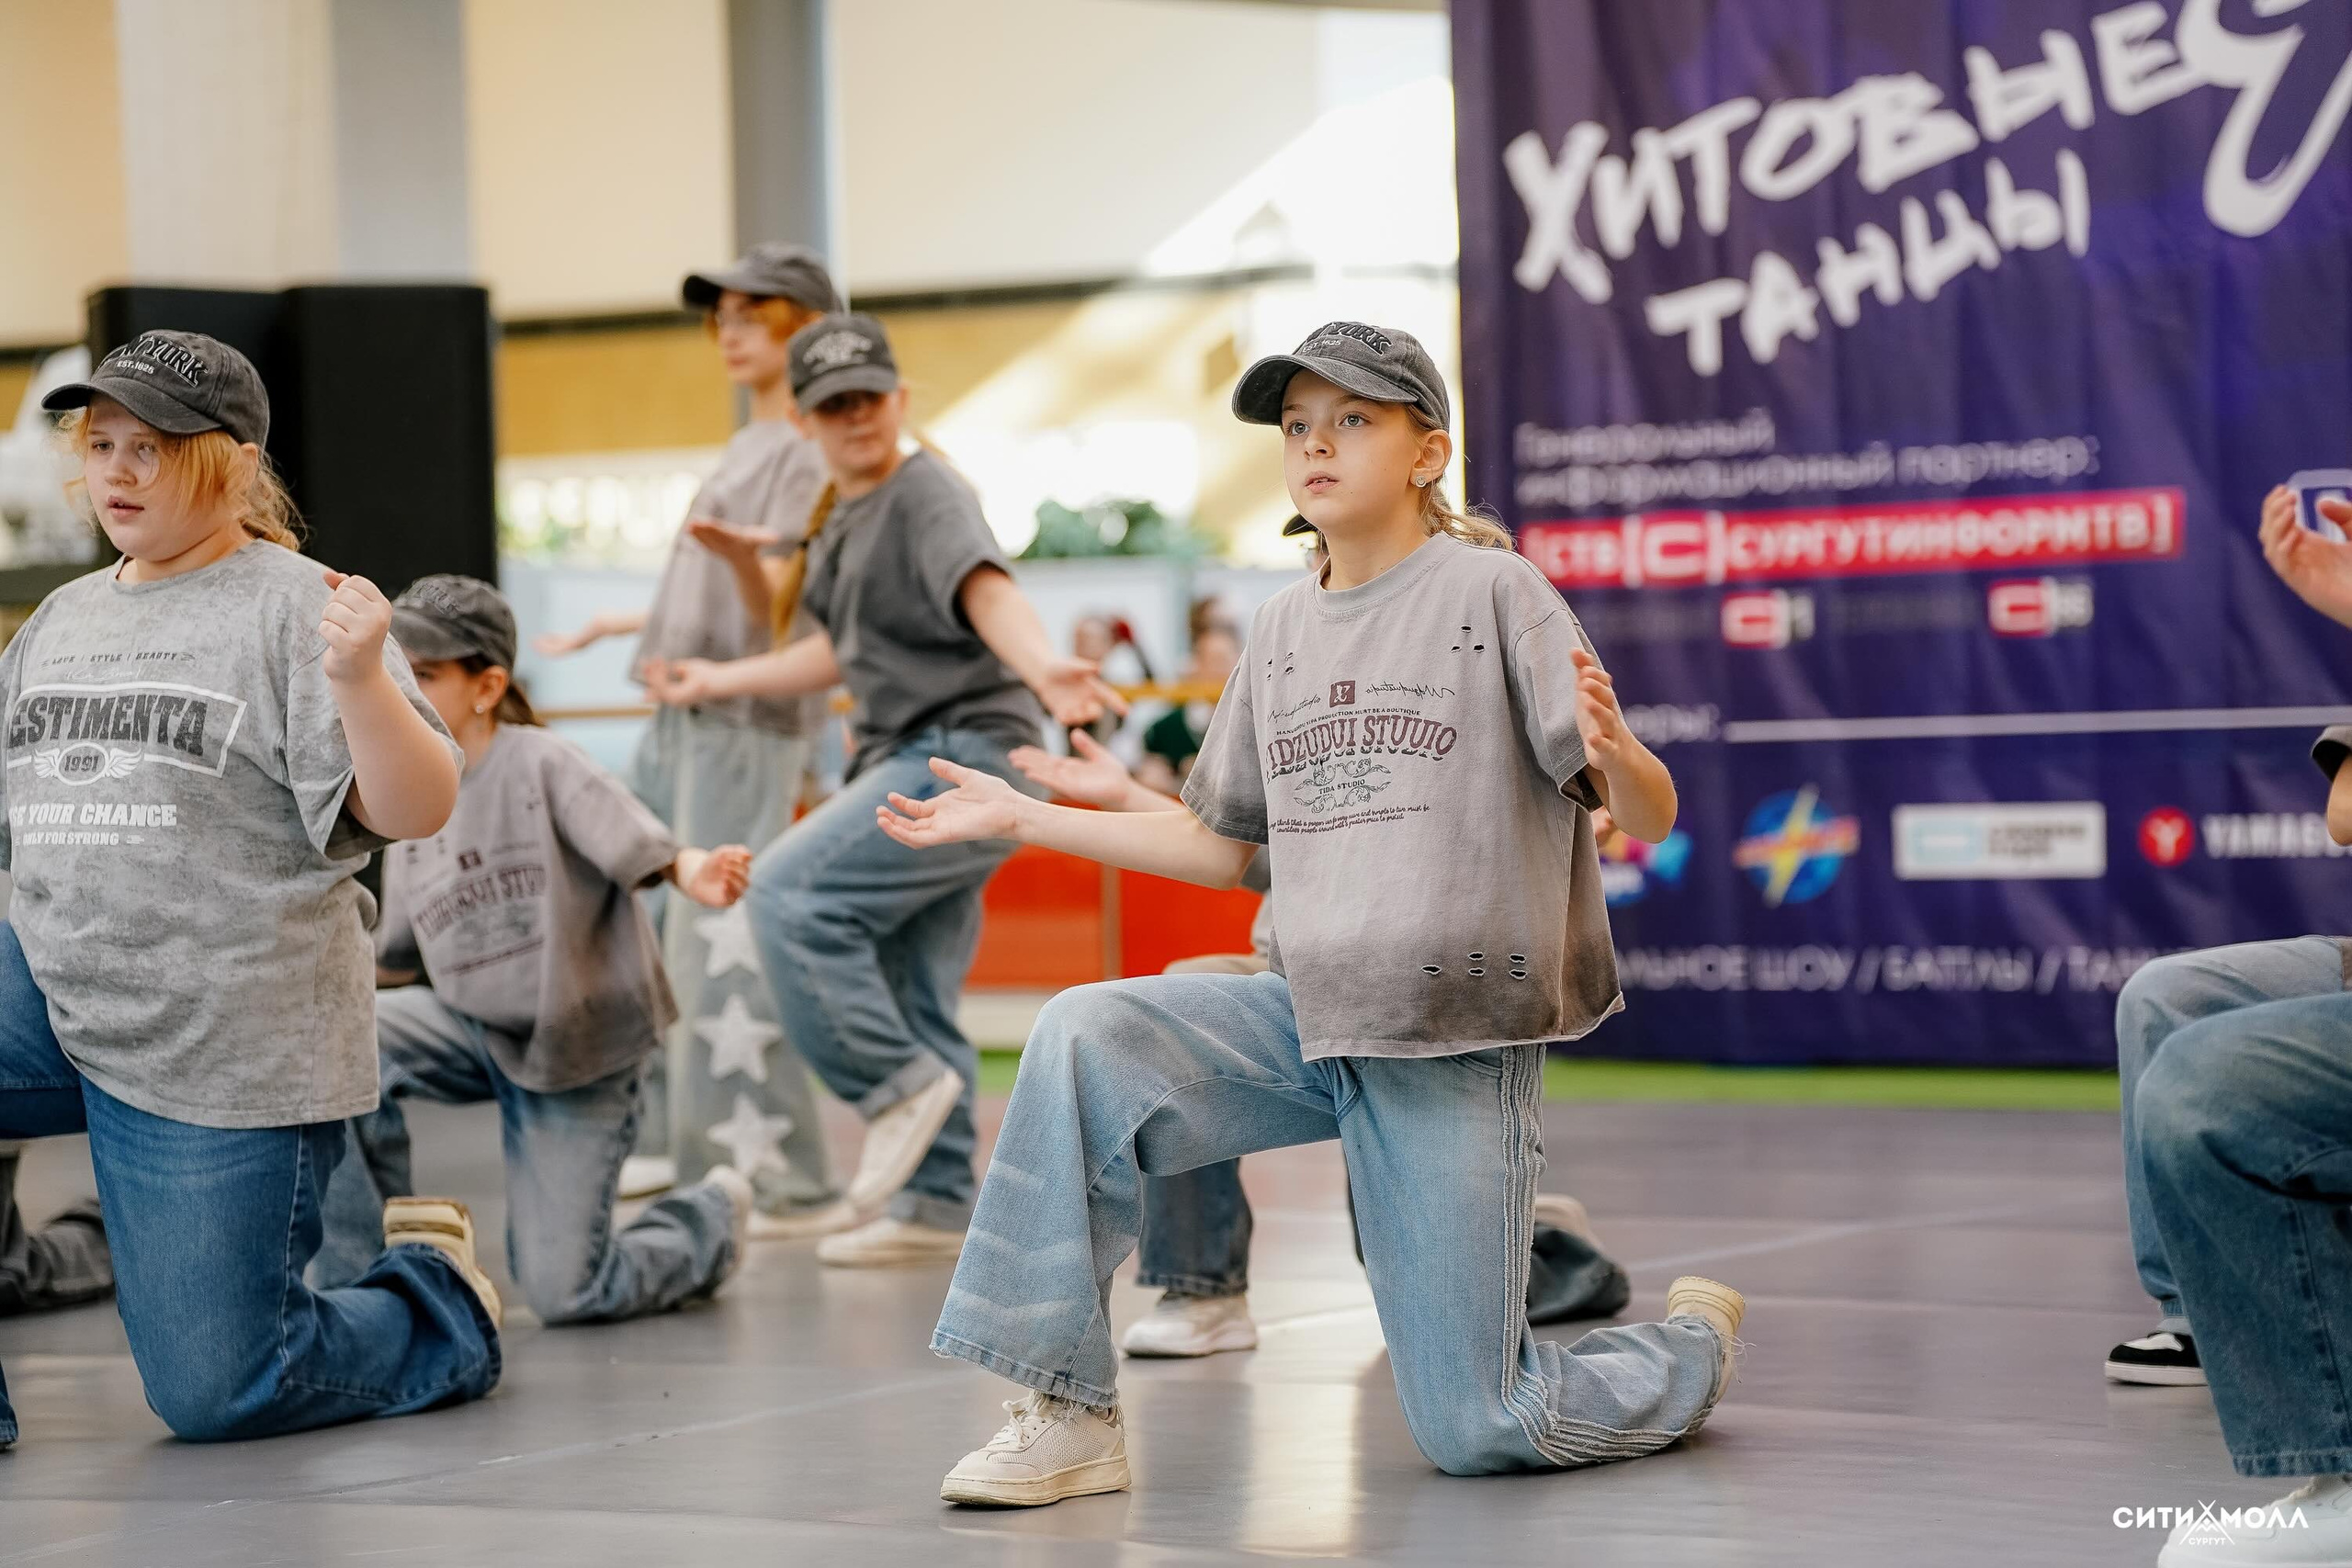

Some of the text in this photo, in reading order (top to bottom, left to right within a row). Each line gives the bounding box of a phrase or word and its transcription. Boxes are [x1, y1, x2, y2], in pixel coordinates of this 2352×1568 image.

[1503, 2, 2196, 304] ХИТОВЫЕ
[1645, 148, 2091, 377] ТАНЦЫ
[1386, 707, 1421, 716] BOUTIQUE
[7, 694, 209, 756] ESTIMENTA
[1337, 779, 1365, 790] STUDIO
[28, 803, 75, 825] YOUR
[79, 803, 177, 827] CHANCE
[45, 831, 66, 845] FOR
[67, 831, 119, 845] STRONG
